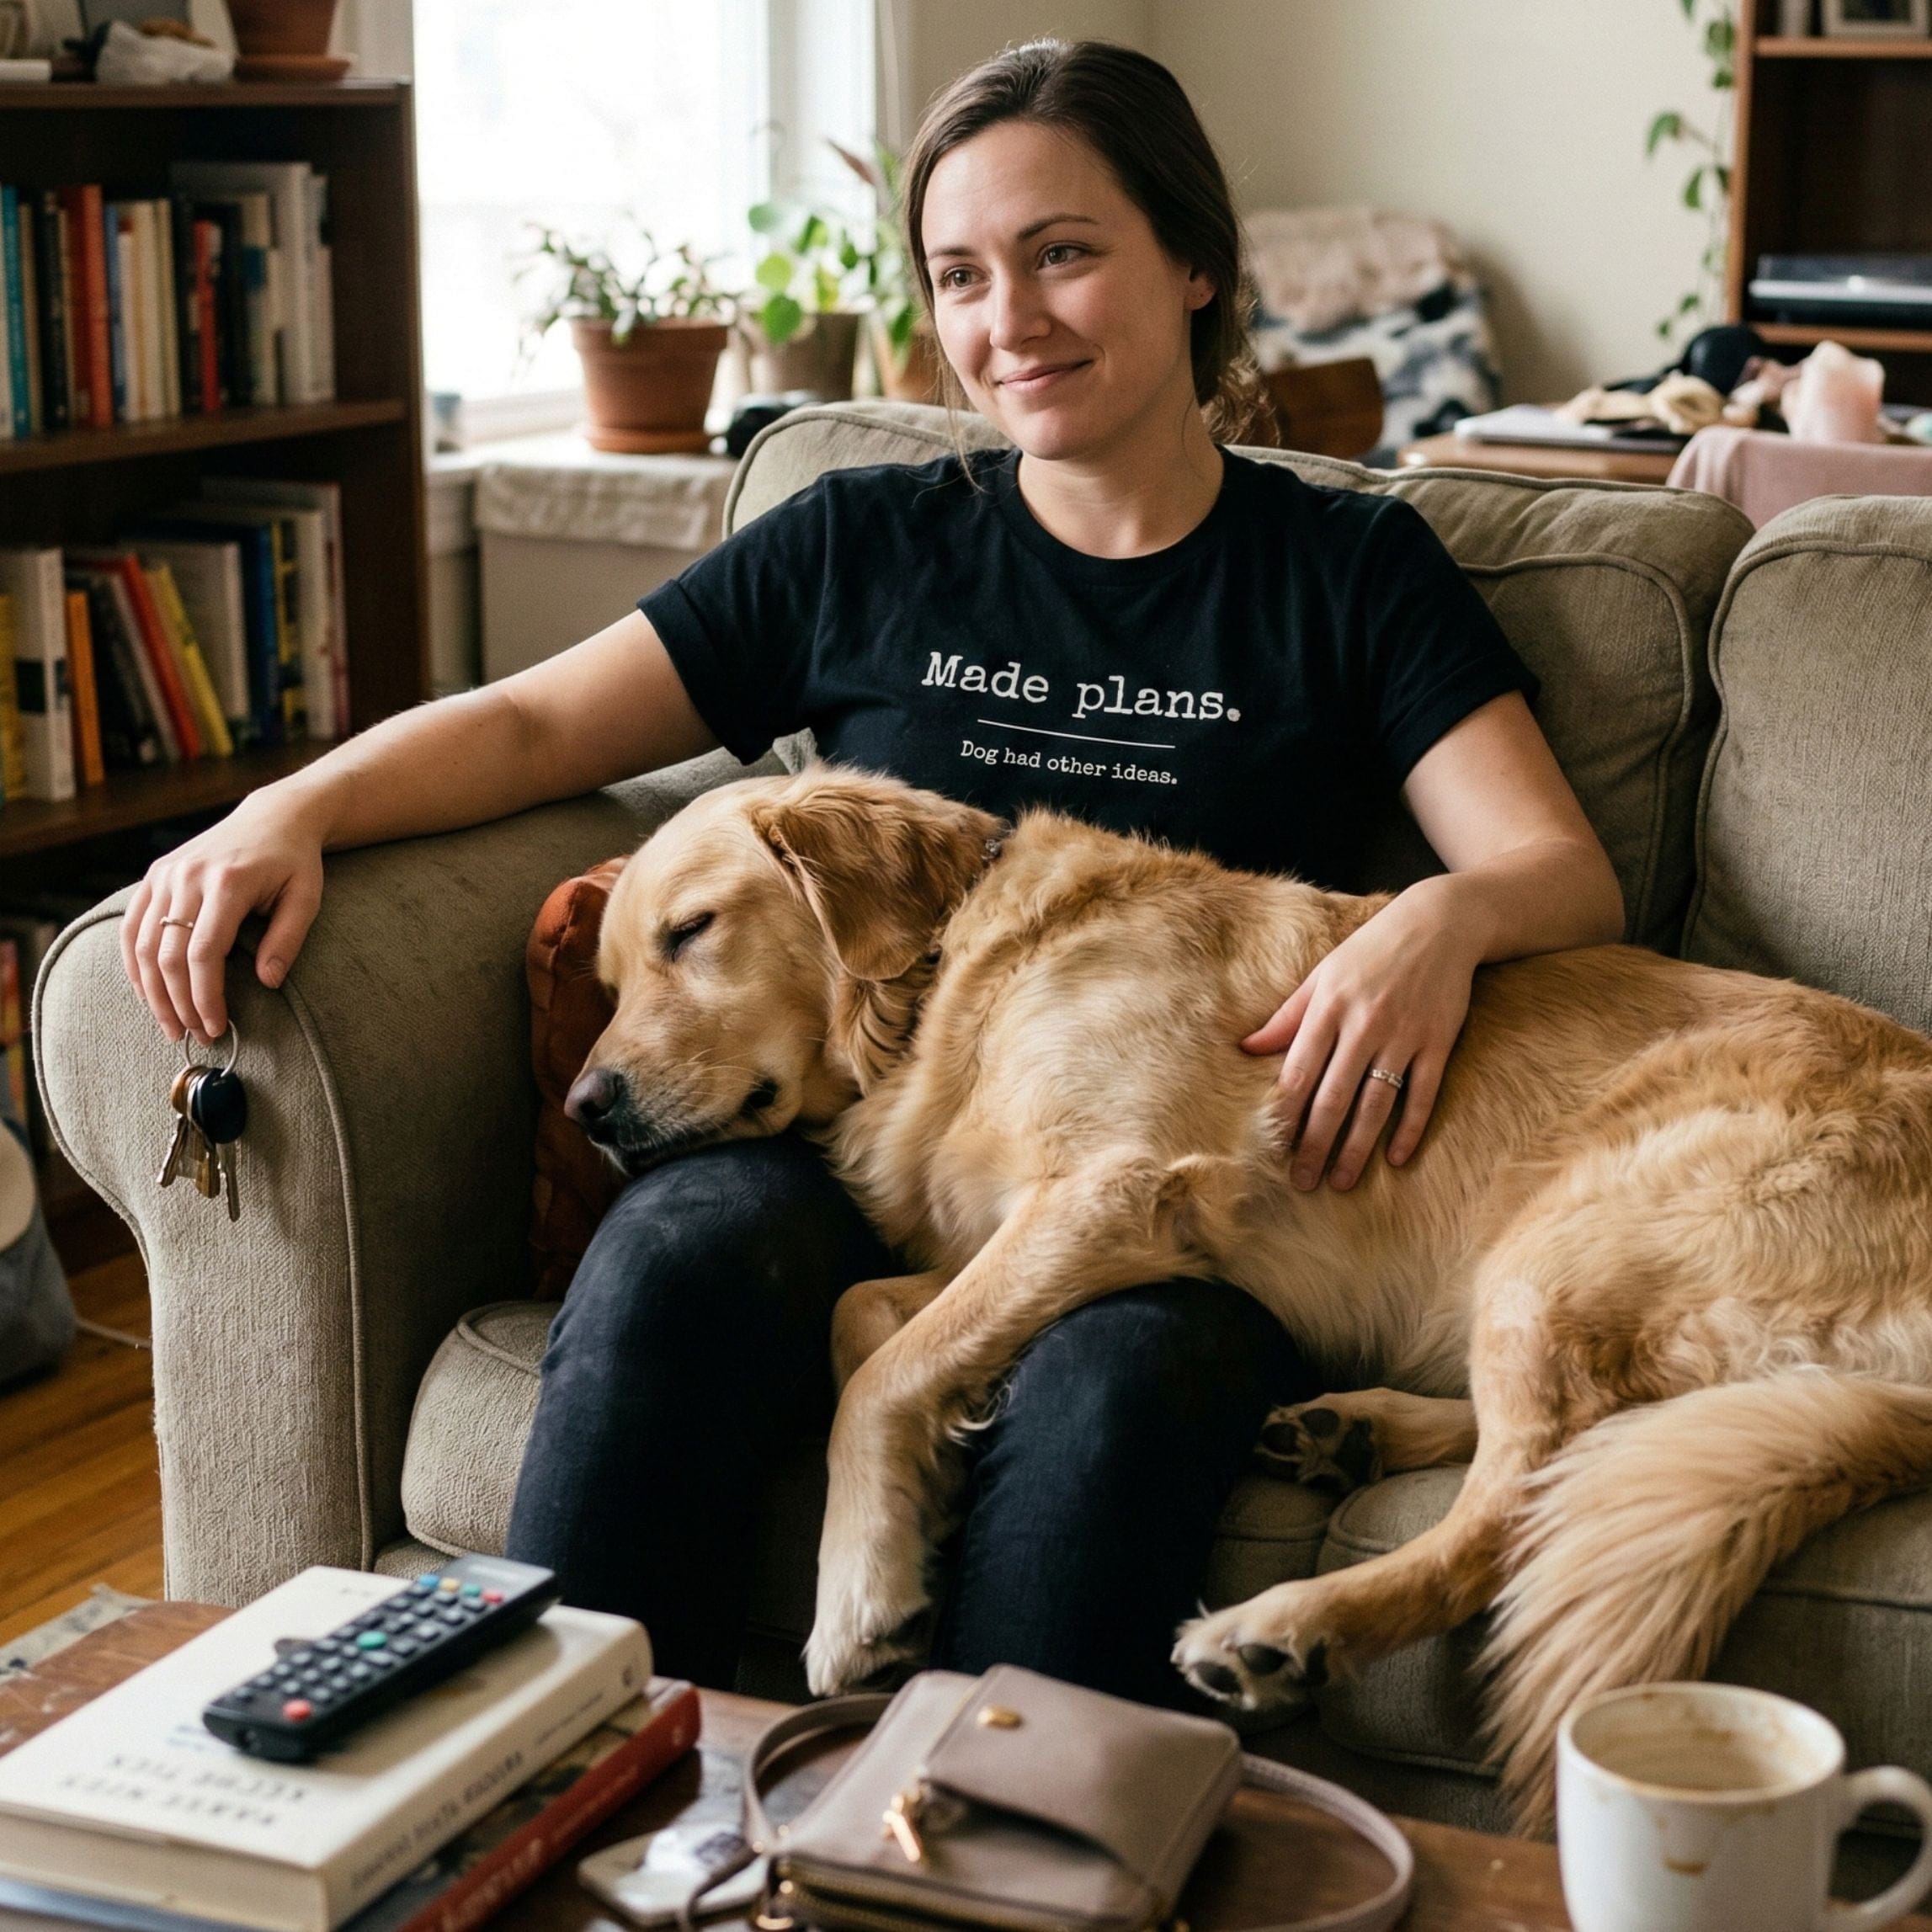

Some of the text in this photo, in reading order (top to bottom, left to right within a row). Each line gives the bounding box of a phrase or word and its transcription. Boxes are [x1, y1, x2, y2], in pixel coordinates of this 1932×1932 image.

[922, 652, 1240, 722] Made plans.
[961, 740, 1178, 785] Dog had other ideas.
